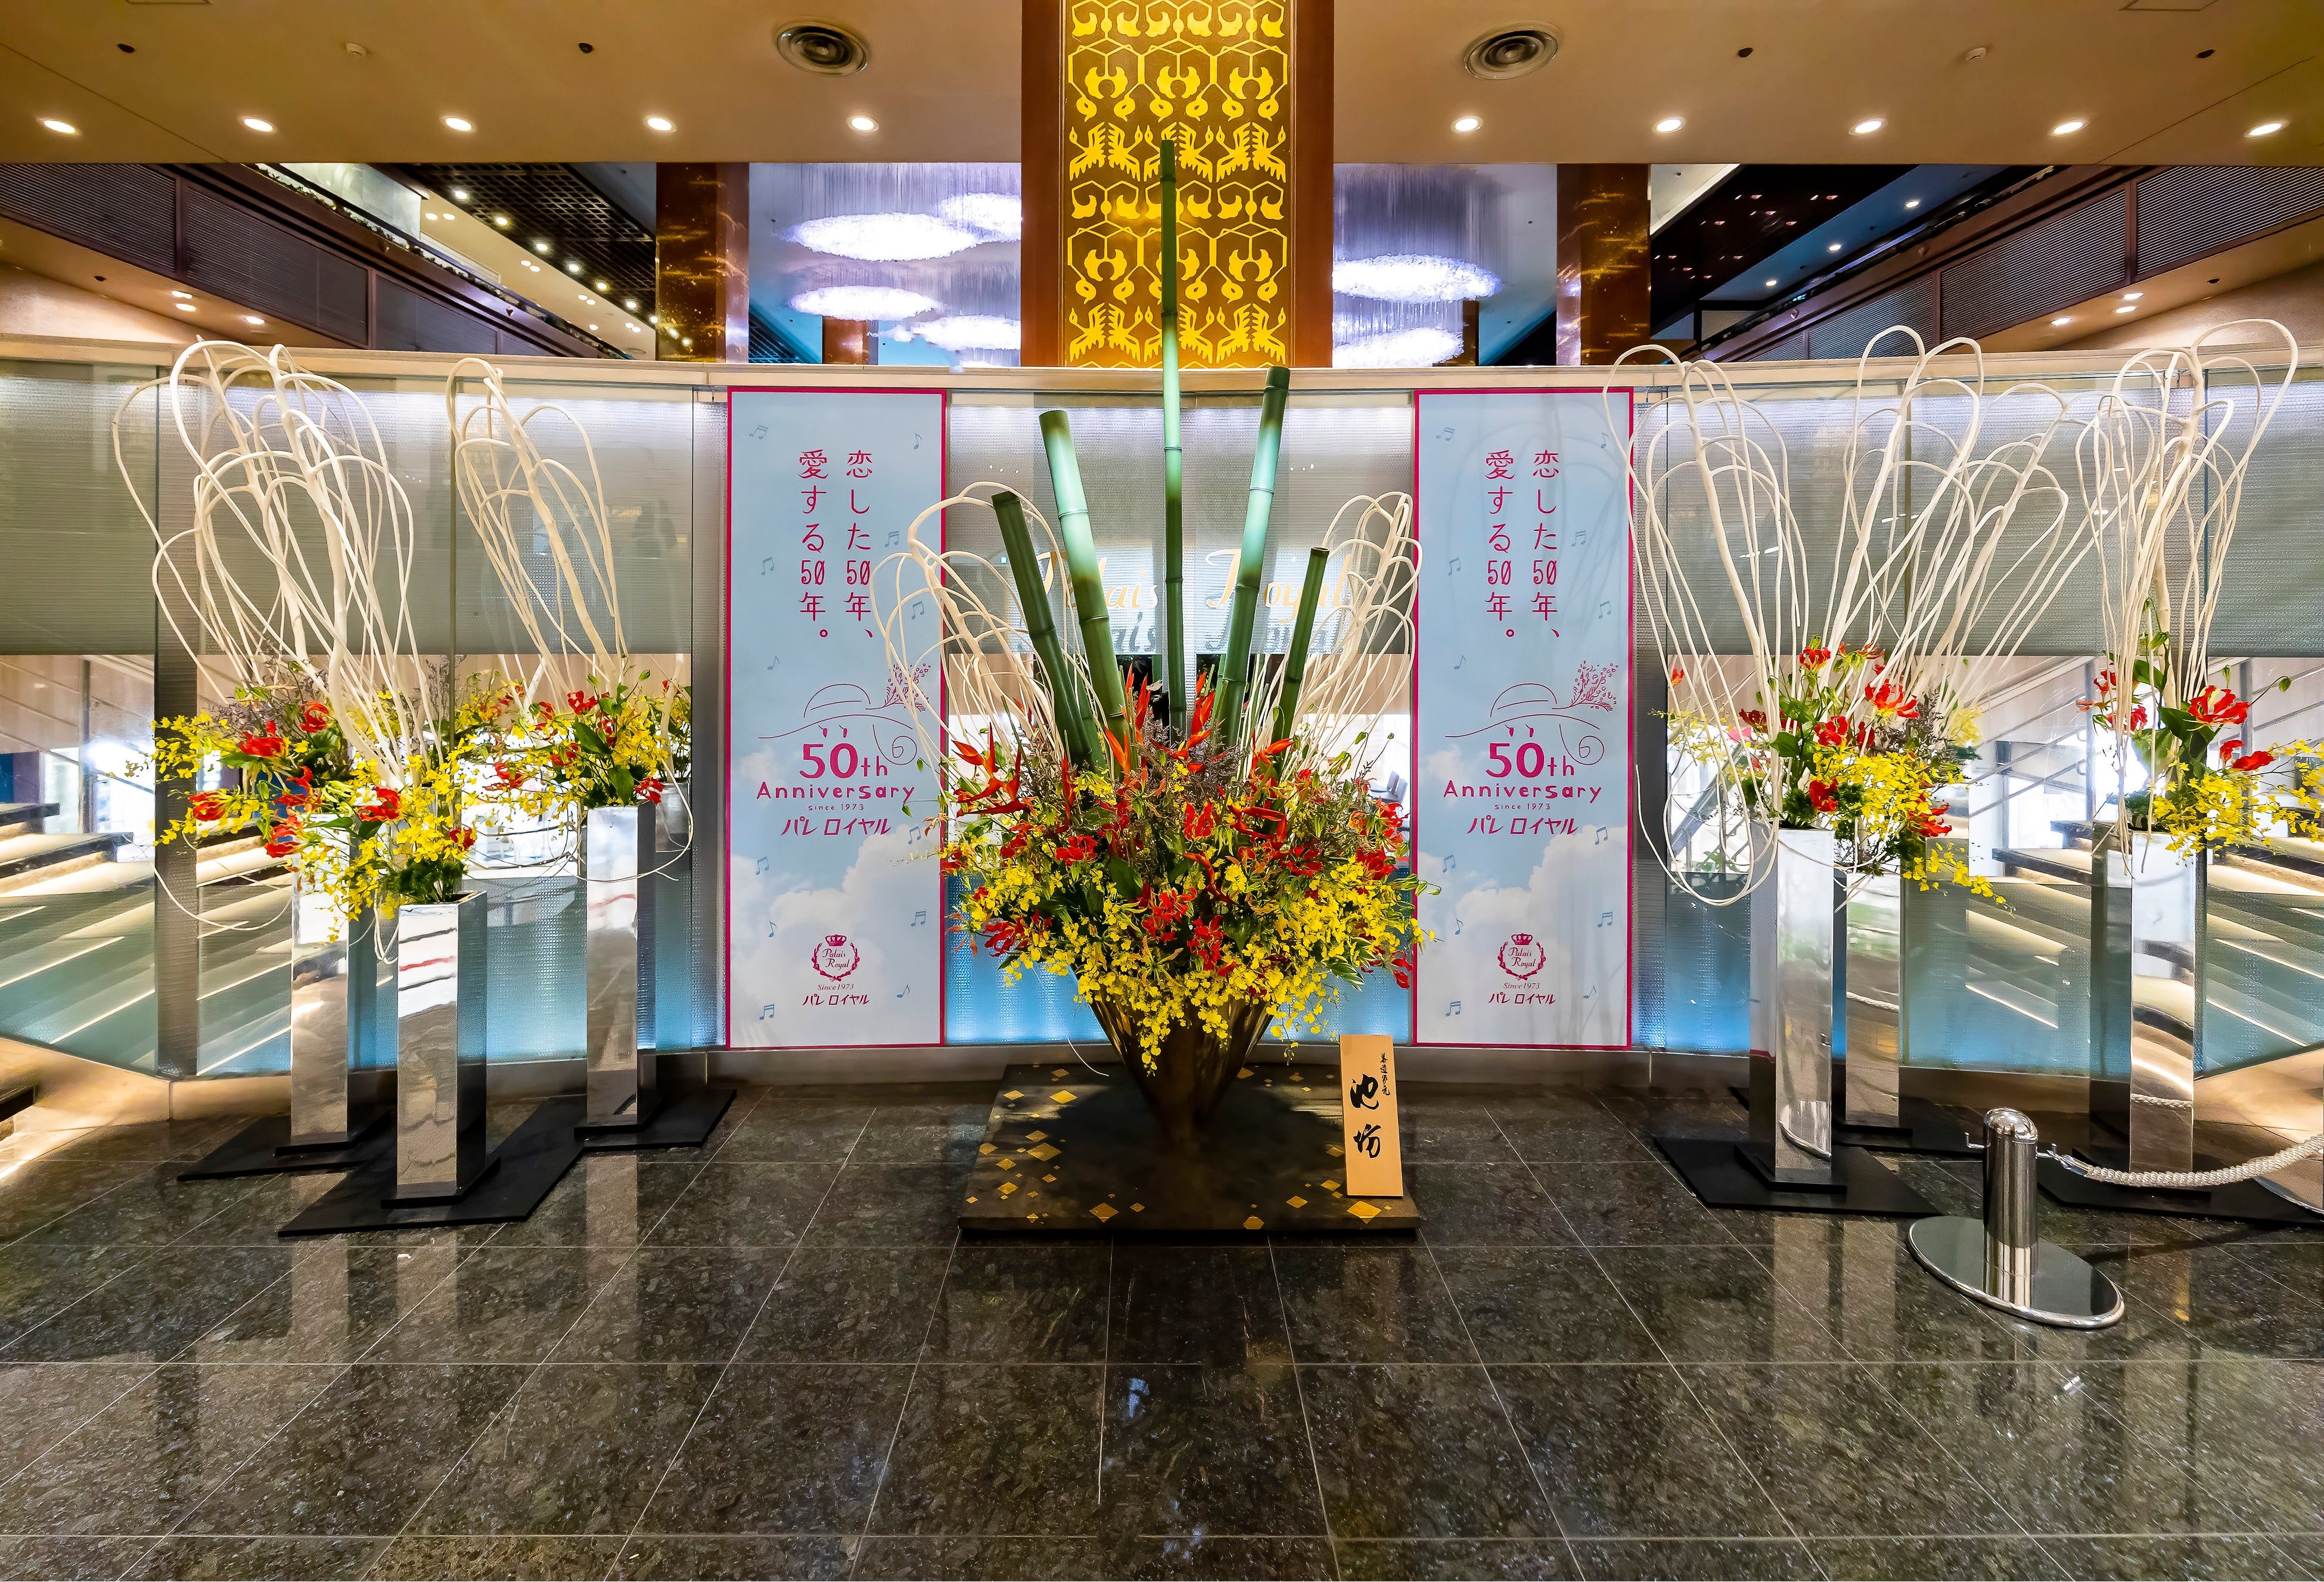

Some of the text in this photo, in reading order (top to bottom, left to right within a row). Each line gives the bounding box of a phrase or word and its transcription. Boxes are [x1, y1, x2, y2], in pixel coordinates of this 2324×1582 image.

[798, 448, 829, 638] 愛する50年。
[844, 449, 874, 638] 恋した50年、
[1484, 449, 1515, 638] 愛する50年。
[1531, 449, 1560, 638] 恋した50年、
[799, 742, 888, 779] 50th
[1485, 741, 1575, 778] 50th
[756, 781, 915, 804] Anniversary
[1443, 779, 1602, 804] Anniversary
[840, 803, 864, 812] 1973
[780, 815, 892, 836] パレ ロイヤル
[1466, 814, 1579, 835] パレ ロイヤル
[822, 948, 846, 958] Palais
[1508, 947, 1532, 957] Palais
[1511, 956, 1536, 969] Royal
[825, 958, 850, 970] Royal
[802, 993, 870, 1006] パレ ロイヤル
[1487, 991, 1556, 1005] パレ ロイヤル
